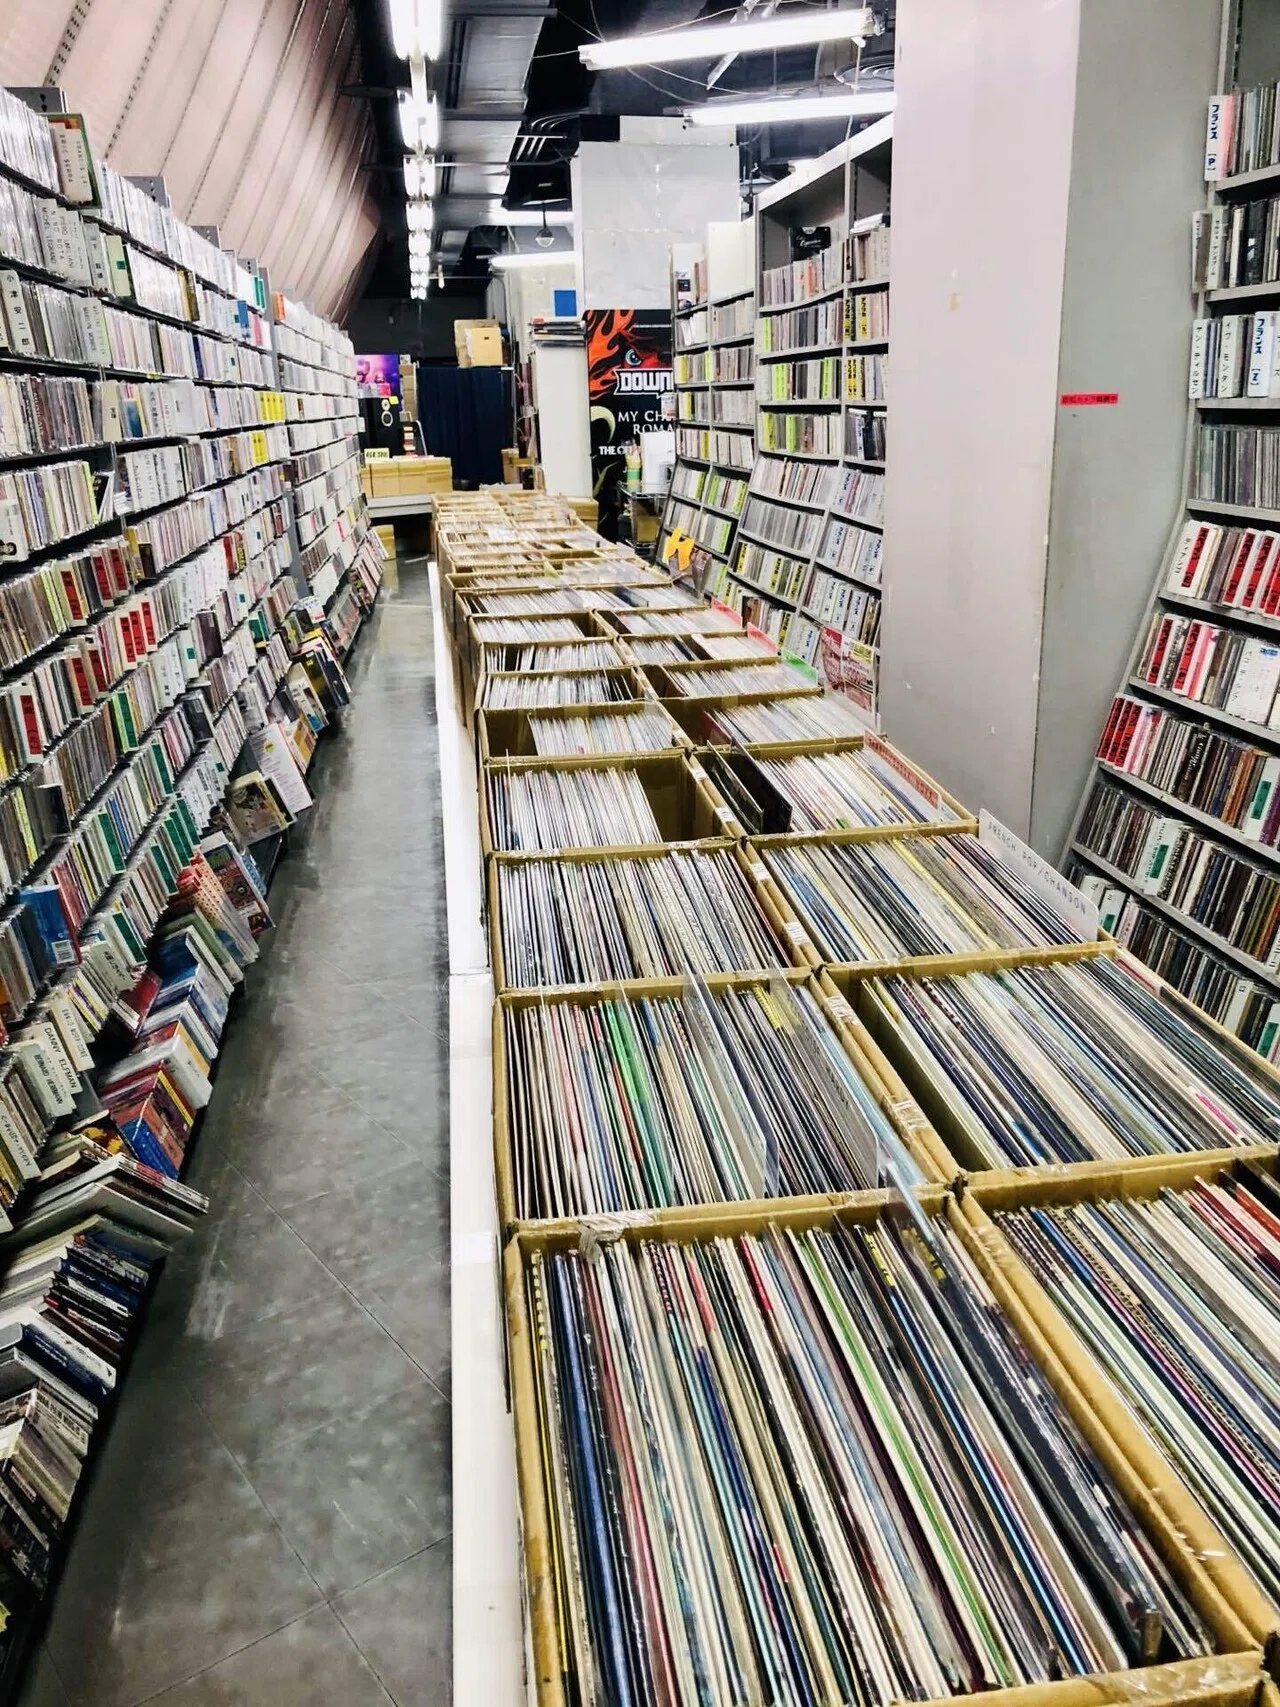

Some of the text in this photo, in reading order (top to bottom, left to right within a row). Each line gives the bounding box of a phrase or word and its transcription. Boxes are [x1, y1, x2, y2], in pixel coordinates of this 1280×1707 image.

[1210, 104, 1220, 140] フランス
[1255, 318, 1266, 354] フランス
[618, 410, 638, 422] MY
[598, 446, 616, 455] THE
[988, 821, 1017, 851] FRENCH
[44, 1027, 77, 1088] DANNY ELFMAN
